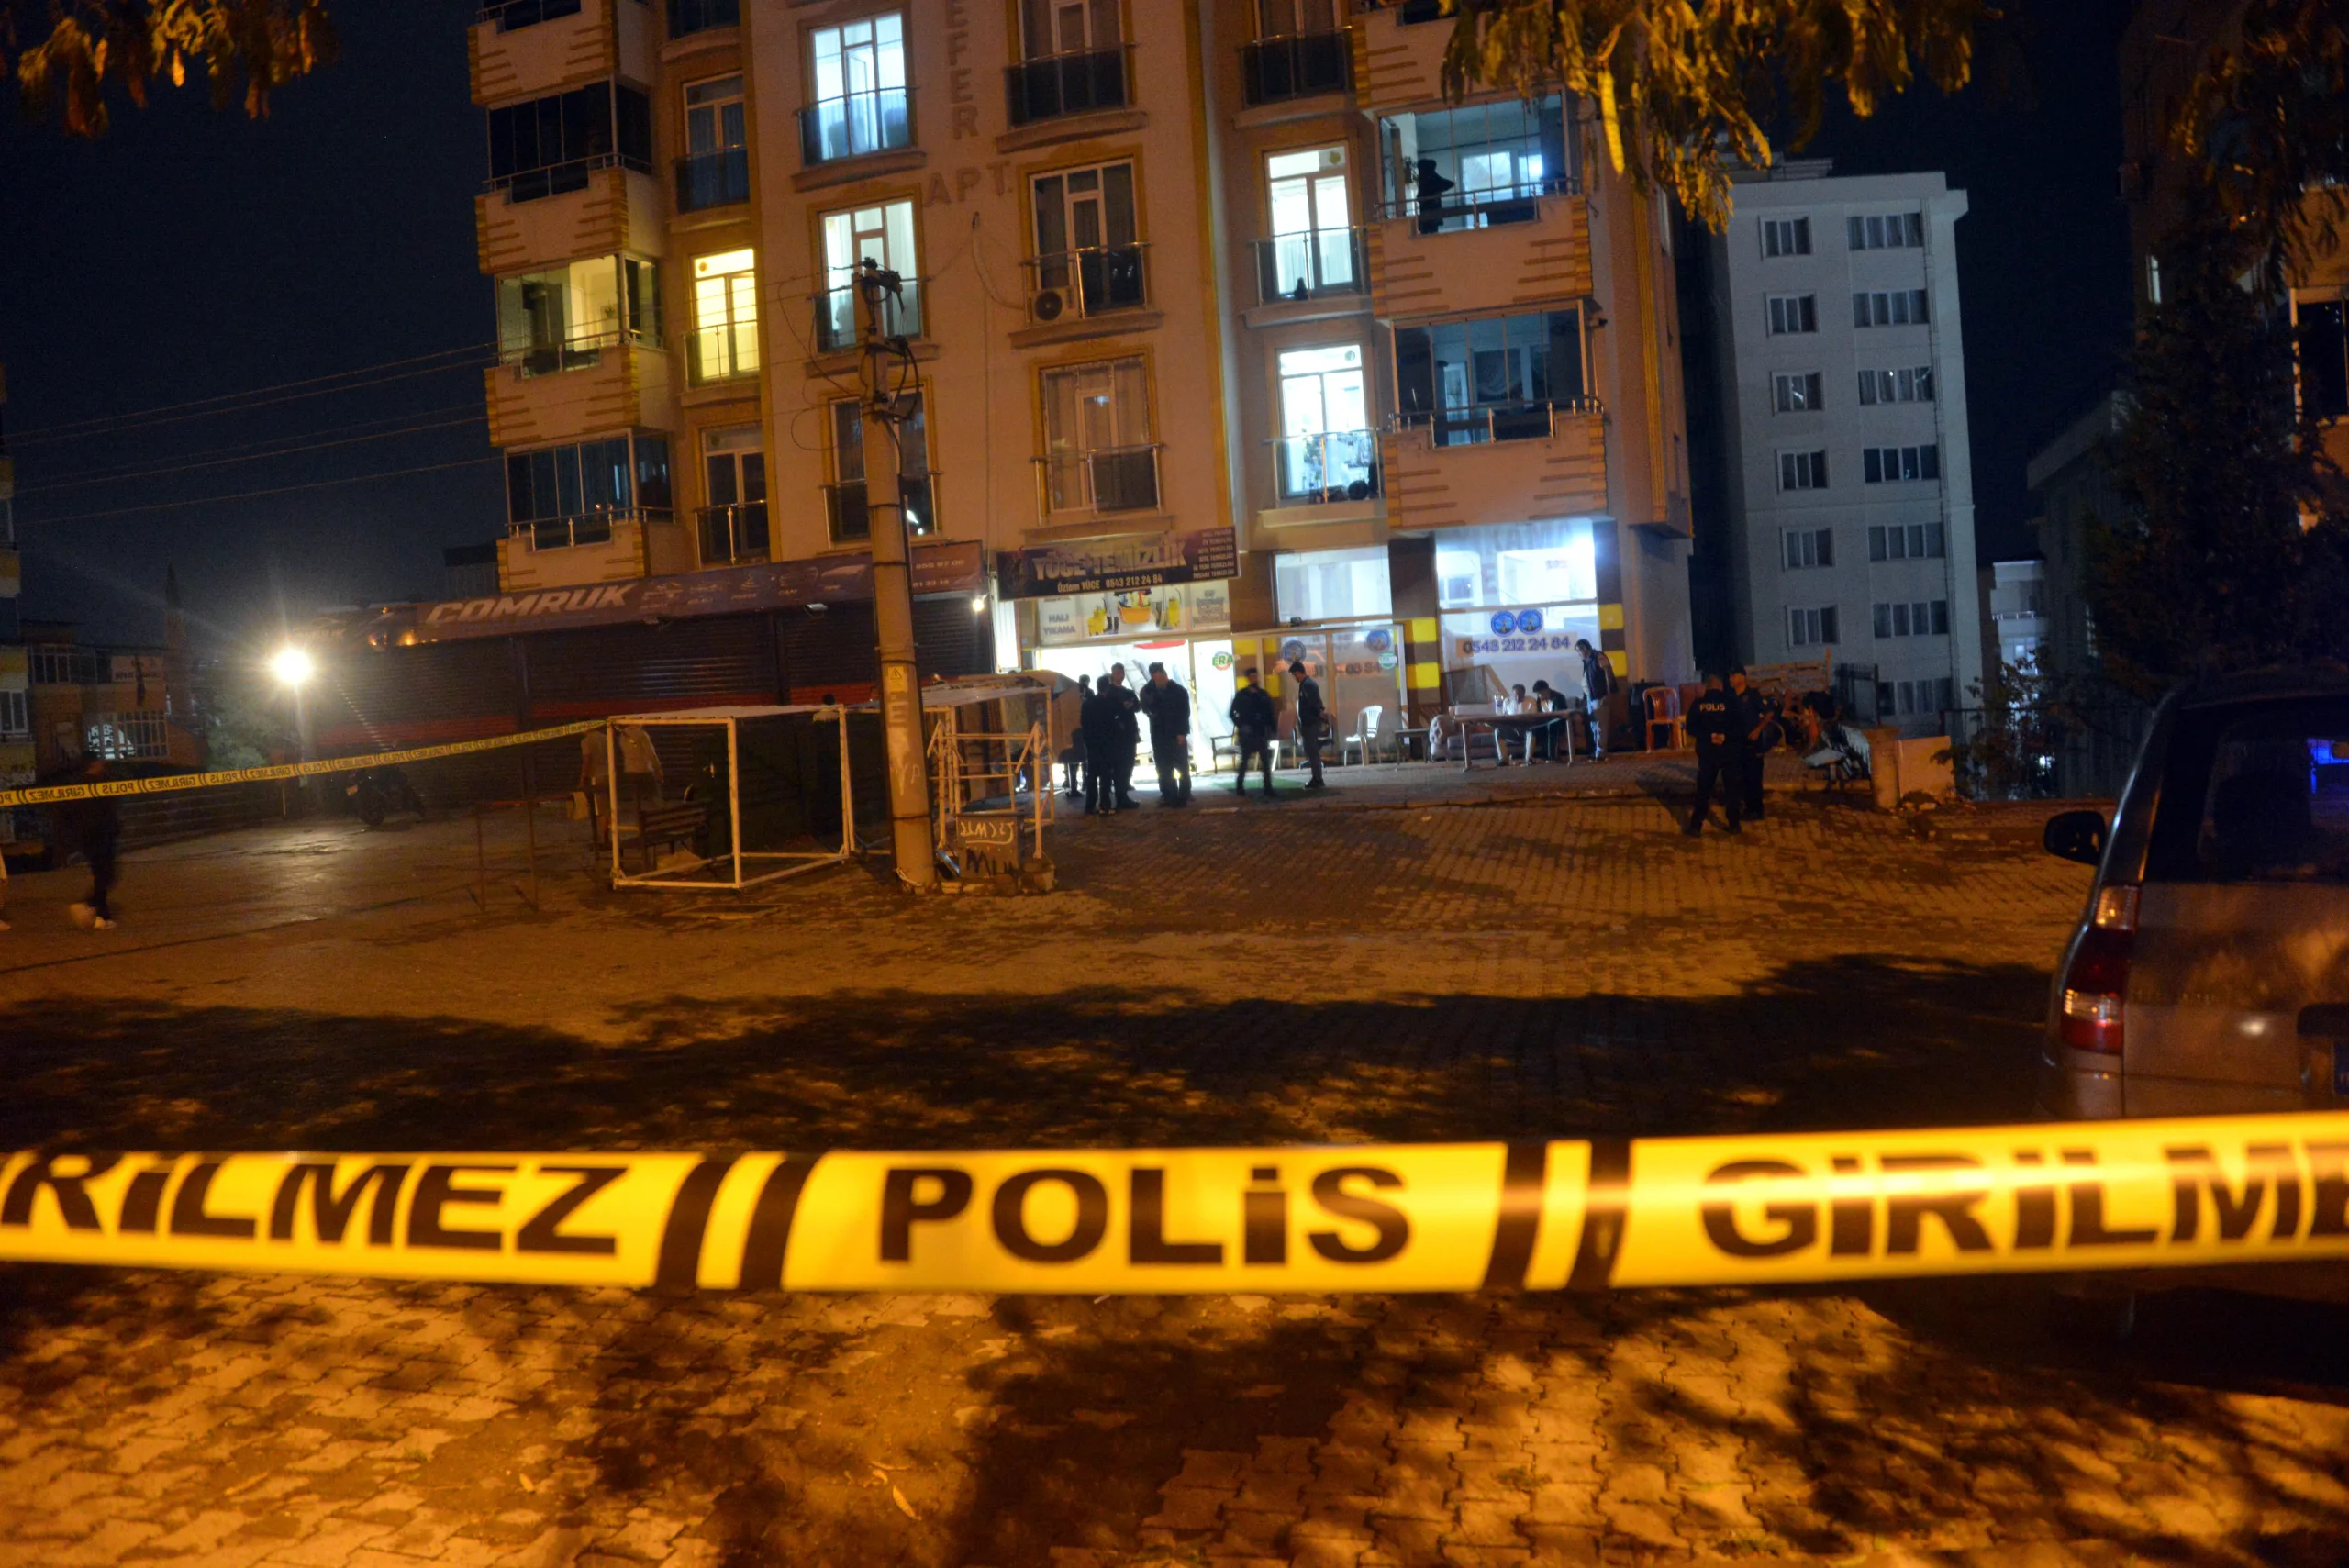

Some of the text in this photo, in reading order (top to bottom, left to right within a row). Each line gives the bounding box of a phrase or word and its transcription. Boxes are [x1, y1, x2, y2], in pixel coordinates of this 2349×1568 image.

[1126, 575, 1140, 586] 212
[1463, 636, 1571, 655] 0543 212 24 84
